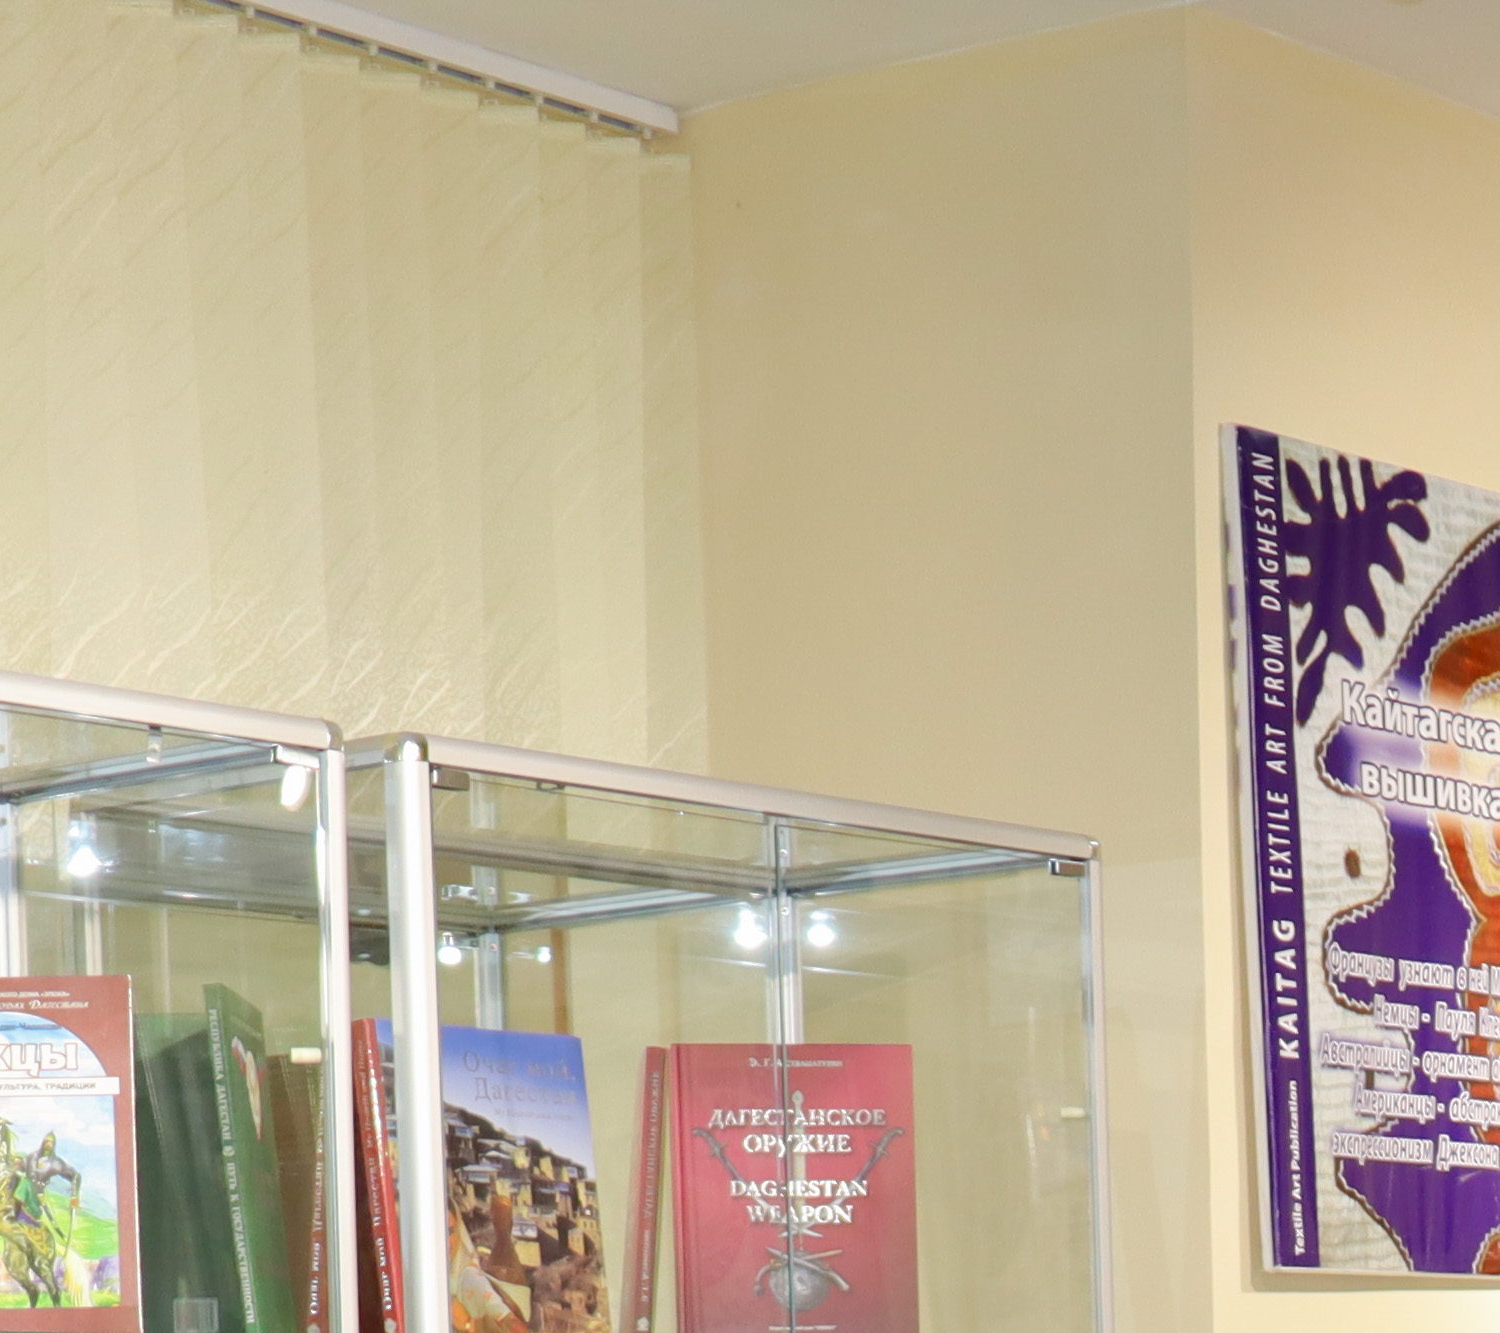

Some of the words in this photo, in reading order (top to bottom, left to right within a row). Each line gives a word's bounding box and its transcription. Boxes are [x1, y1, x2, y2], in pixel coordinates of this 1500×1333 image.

[1251, 452, 1282, 612] DAGHESTAN
[1261, 633, 1286, 709] FROM
[1265, 722, 1288, 775] ART
[1268, 788, 1294, 895] TEXTILE
[1272, 917, 1300, 1060] KAITAG
[1328, 942, 1395, 987] Французы
[1398, 958, 1455, 991] узнают
[1456, 967, 1468, 990] в
[1468, 963, 1489, 994] ней
[1373, 994, 1420, 1030] Немцы
[1435, 1000, 1476, 1041] Пауля
[209, 1008, 224, 1081] РЕСПУБЛИКА
[1320, 1033, 1412, 1077] Австралийцы
[1422, 1050, 1490, 1083] орнамент
[45, 1081, 96, 1090] ТРАДИЦИИ
[474, 1077, 577, 1107] Дагестан
[1355, 1085, 1437, 1125] Американцы
[218, 1084, 233, 1142] ДАГЕСТАН
[707, 1108, 887, 1130] ДАГЕСТАНСКОЕ
[1289, 1080, 1300, 1171] Publication
[742, 1133, 853, 1158] ОРУЖИЕ
[1332, 1131, 1434, 1166] экспрессионизм
[1435, 1134, 1500, 1172] Джексона
[226, 1161, 240, 1190] ПУТЬ
[231, 1193, 241, 1203] К
[1292, 1173, 1301, 1199] Art
[746, 1205, 854, 1224] WEAPON
[1292, 1203, 1305, 1256] Textile
[233, 1205, 255, 1326] ГОСУДАРСТВЕННОСТИ
